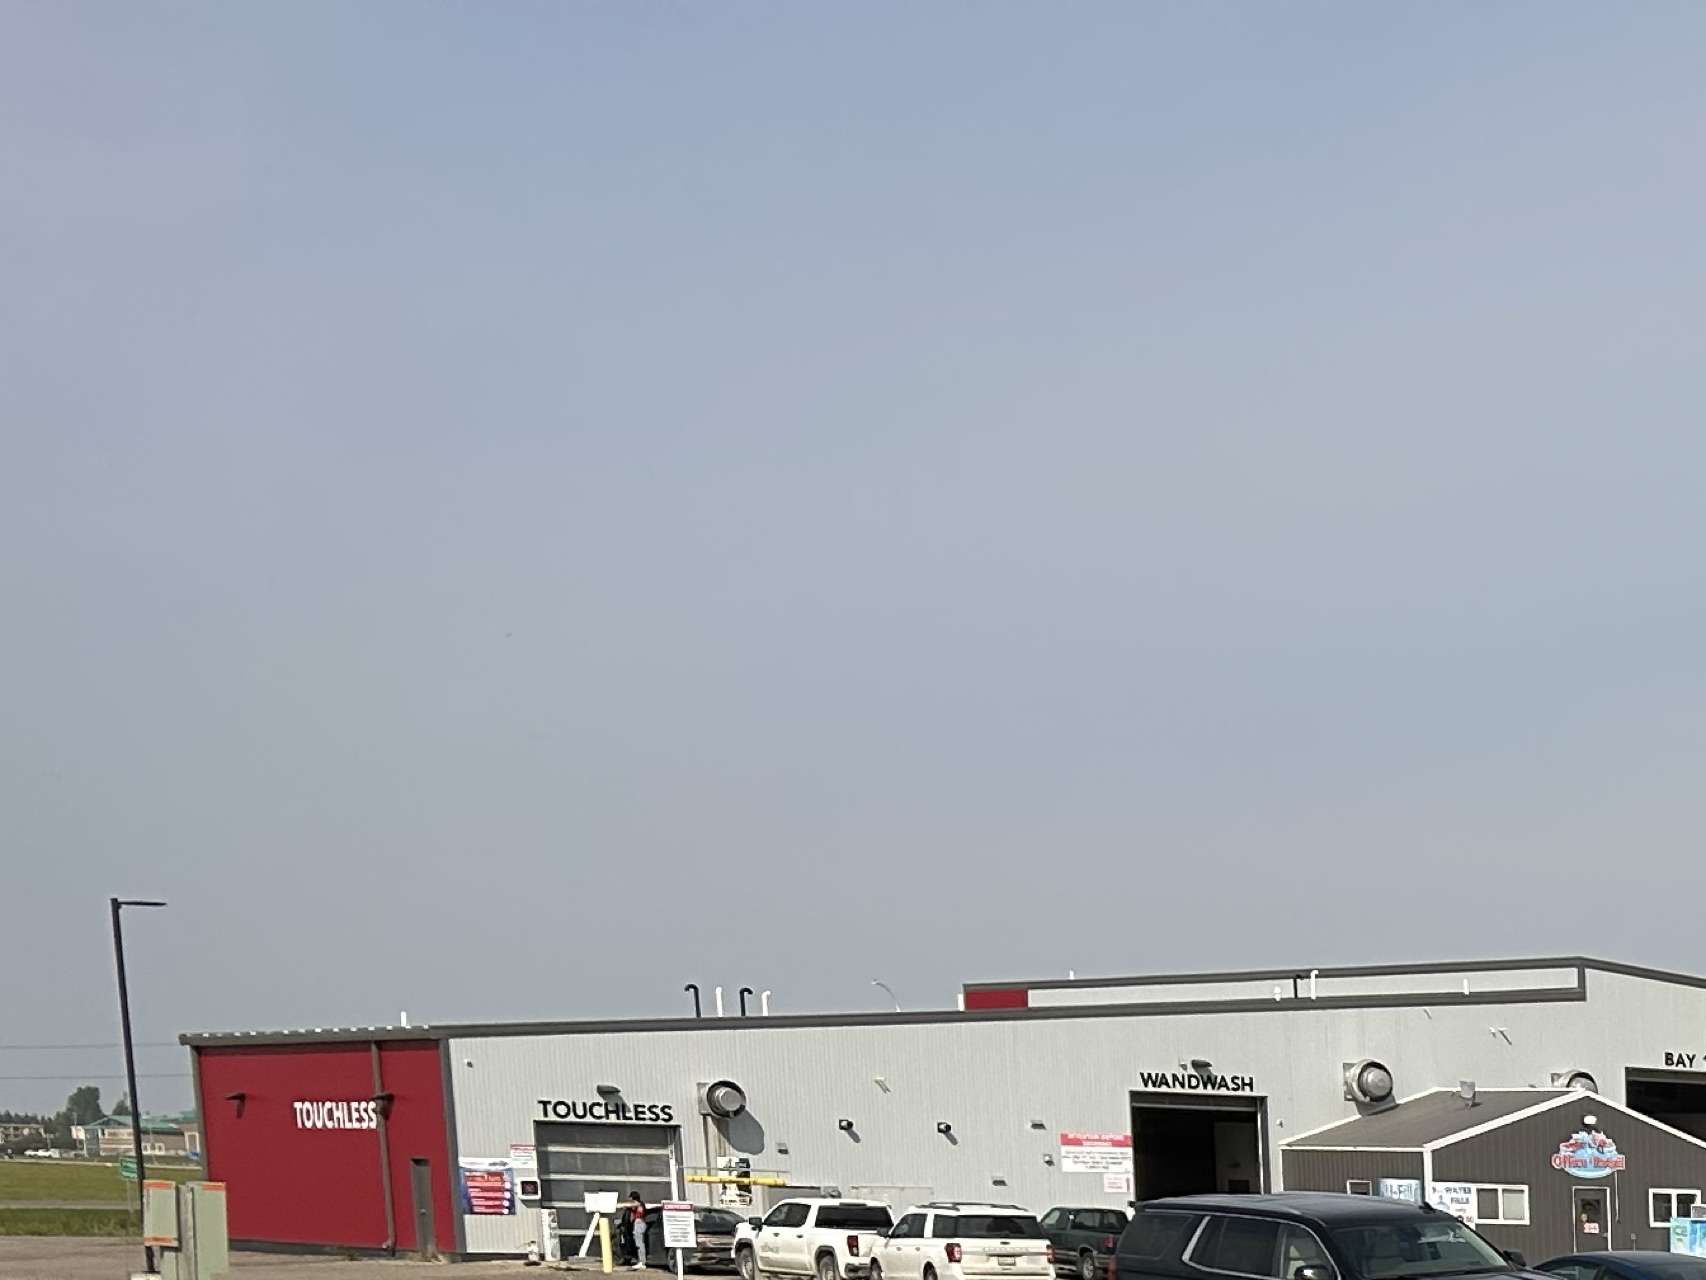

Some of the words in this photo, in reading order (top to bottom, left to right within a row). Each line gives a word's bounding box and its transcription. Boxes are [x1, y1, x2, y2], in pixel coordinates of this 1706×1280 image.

[1664, 1052, 1697, 1070] BAY
[1140, 1072, 1254, 1092] WANDWASH
[293, 1101, 377, 1129] TOUCHLESS
[537, 1100, 674, 1122] TOUCHLESS
